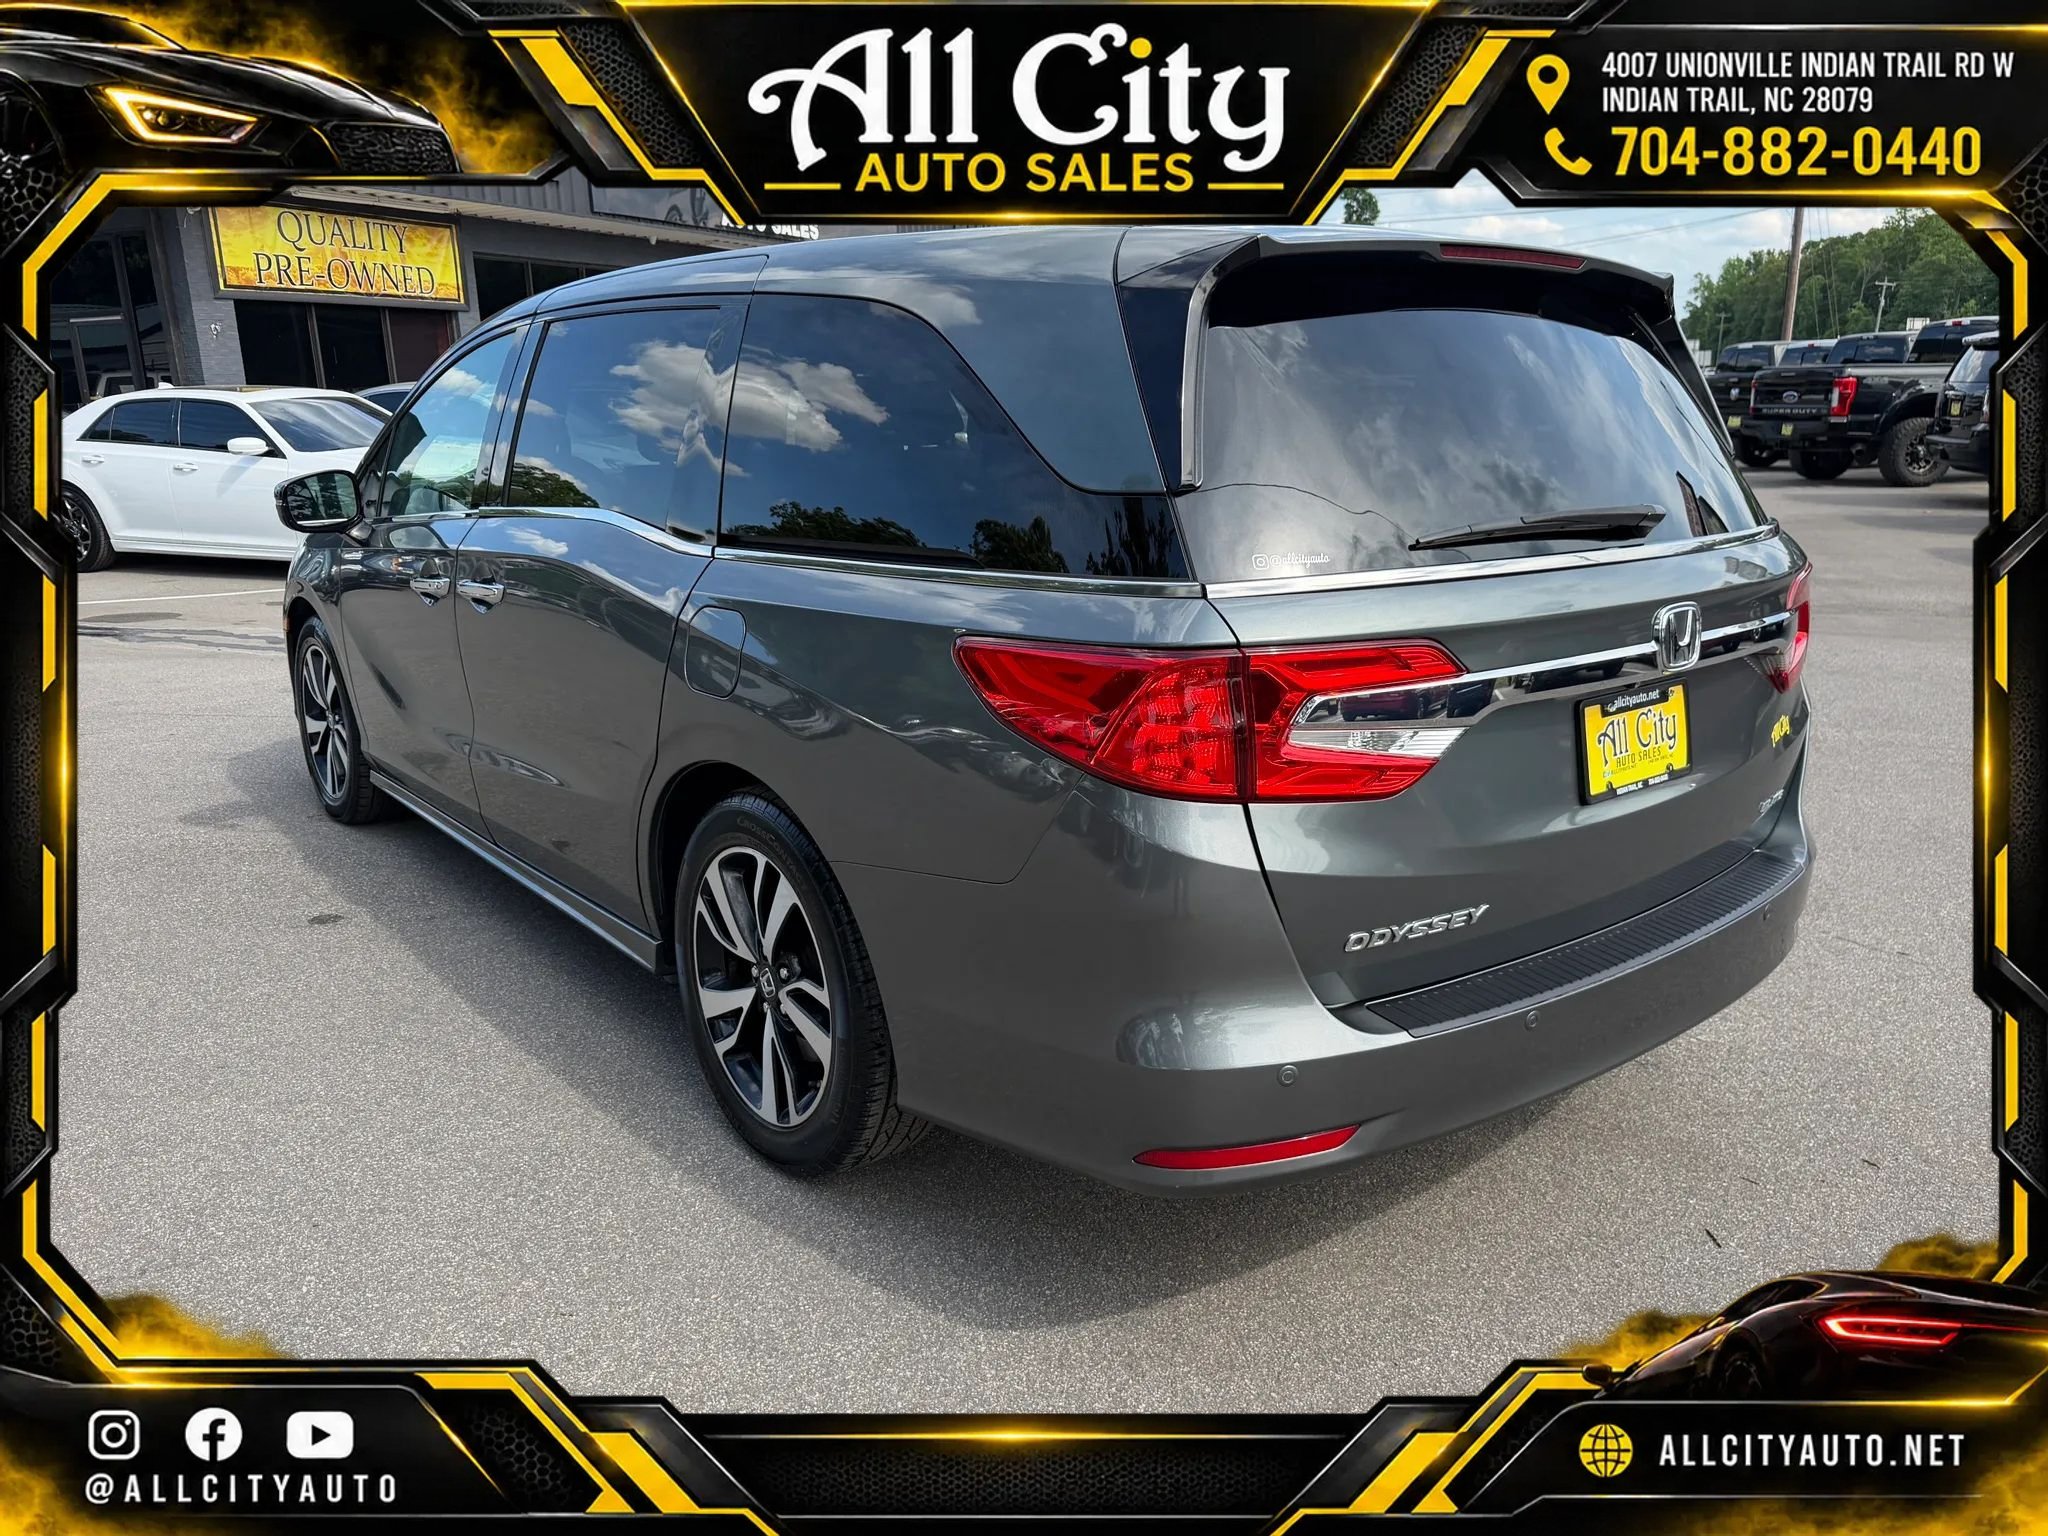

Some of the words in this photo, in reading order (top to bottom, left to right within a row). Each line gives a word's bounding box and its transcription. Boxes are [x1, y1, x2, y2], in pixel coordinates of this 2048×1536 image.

[277, 210, 407, 254] QUALITY
[771, 224, 819, 240] SALES
[253, 252, 435, 295] PRE-OWNED
[1613, 689, 1660, 709] allcityauto.net
[1597, 716, 1629, 767] All
[1636, 707, 1677, 750] City
[1616, 753, 1636, 768] AUTO
[1638, 746, 1661, 762] SALES
[1344, 903, 1490, 952] ODYSSEY
